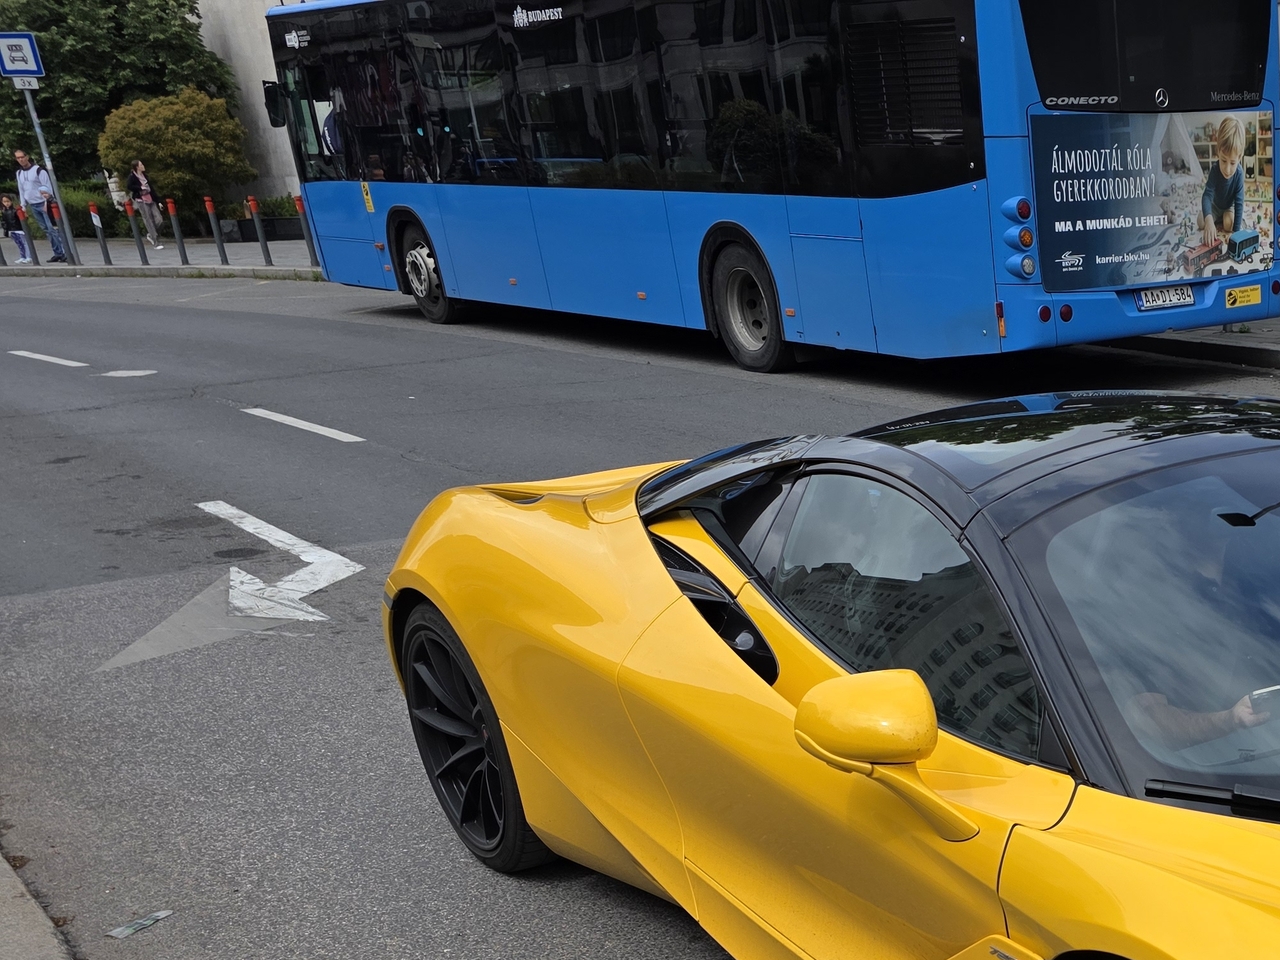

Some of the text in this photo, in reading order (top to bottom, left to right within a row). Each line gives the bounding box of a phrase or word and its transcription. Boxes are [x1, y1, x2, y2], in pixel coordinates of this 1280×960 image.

[527, 7, 563, 22] BUDAPEST
[1045, 95, 1119, 105] CONECTO
[1210, 90, 1260, 102] Mercedes-Benz
[1051, 143, 1152, 174] ÁLMODOZTÁL RÓLA
[1053, 173, 1156, 203] GYEREKKORODBAN?
[1054, 214, 1168, 233] MA A MUNKÁD LEHET!
[1095, 251, 1150, 265] karrier.bkv.hu
